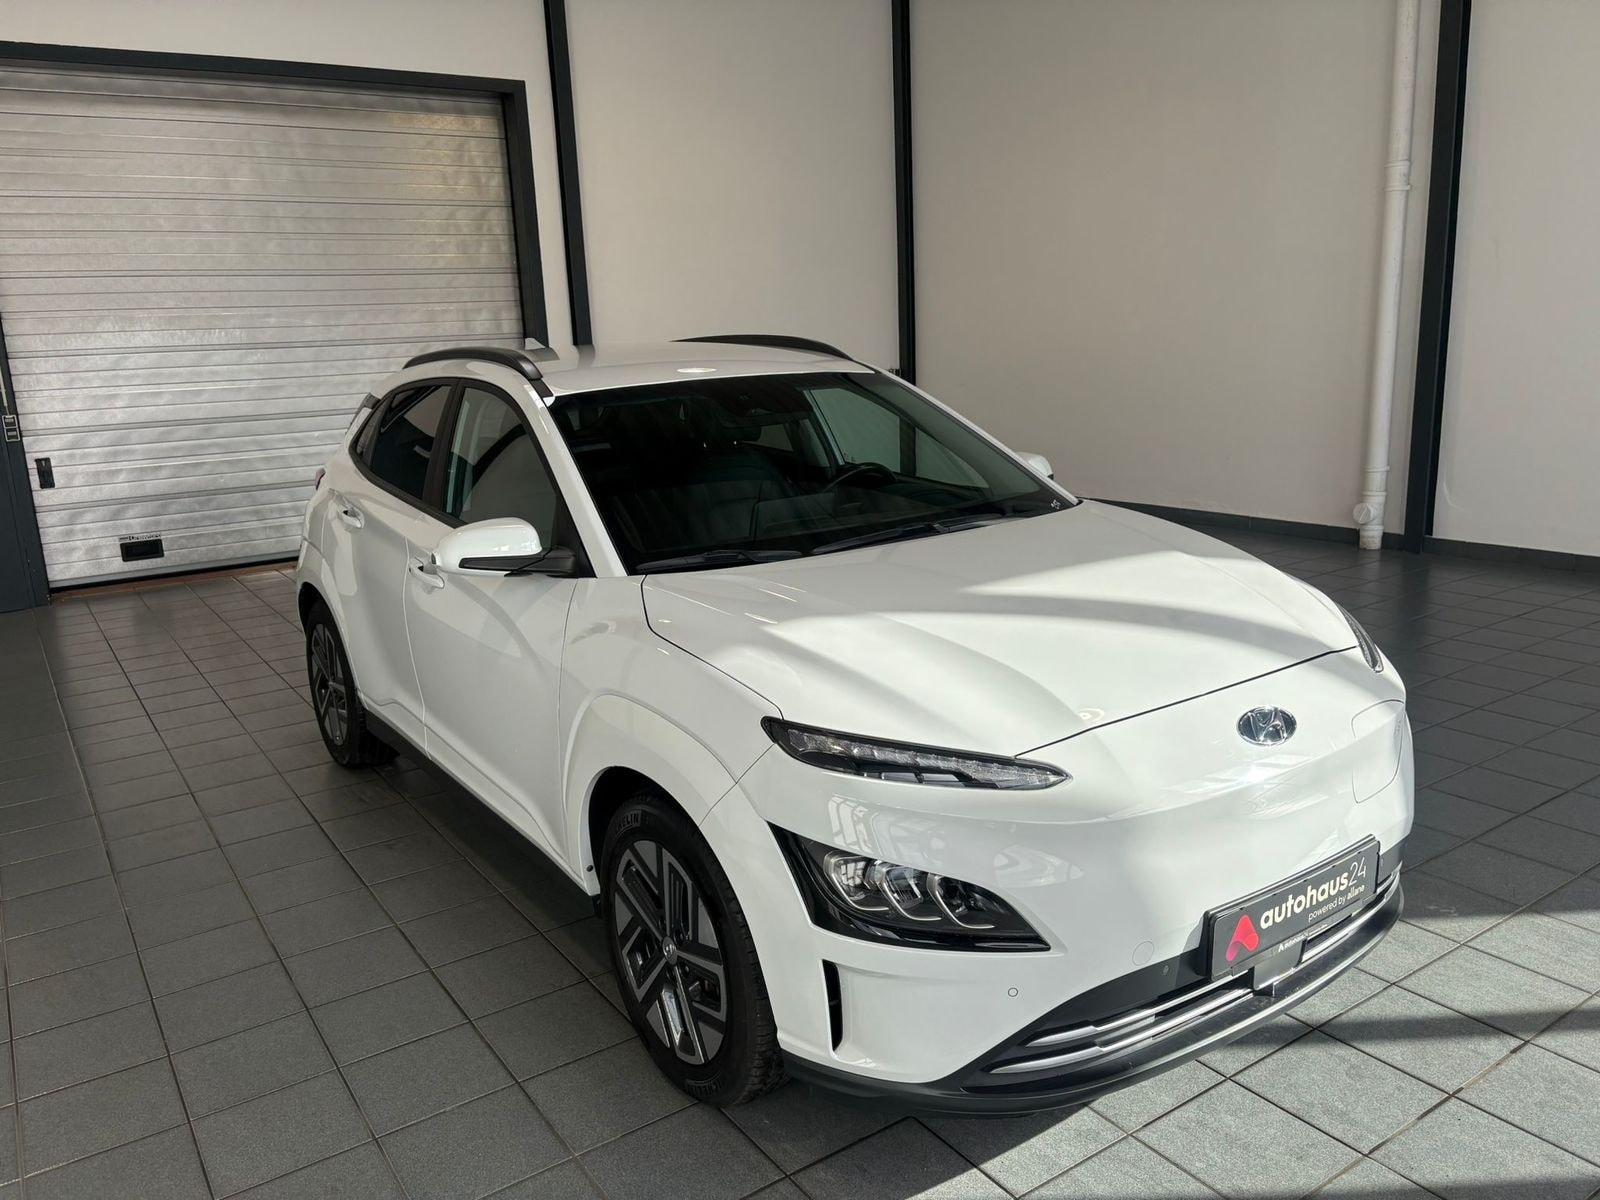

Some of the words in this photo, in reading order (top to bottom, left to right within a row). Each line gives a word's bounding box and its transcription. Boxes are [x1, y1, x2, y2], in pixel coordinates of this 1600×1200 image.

[1260, 857, 1366, 929] autohaus24
[1308, 898, 1338, 922] powered
[1338, 895, 1346, 905] by
